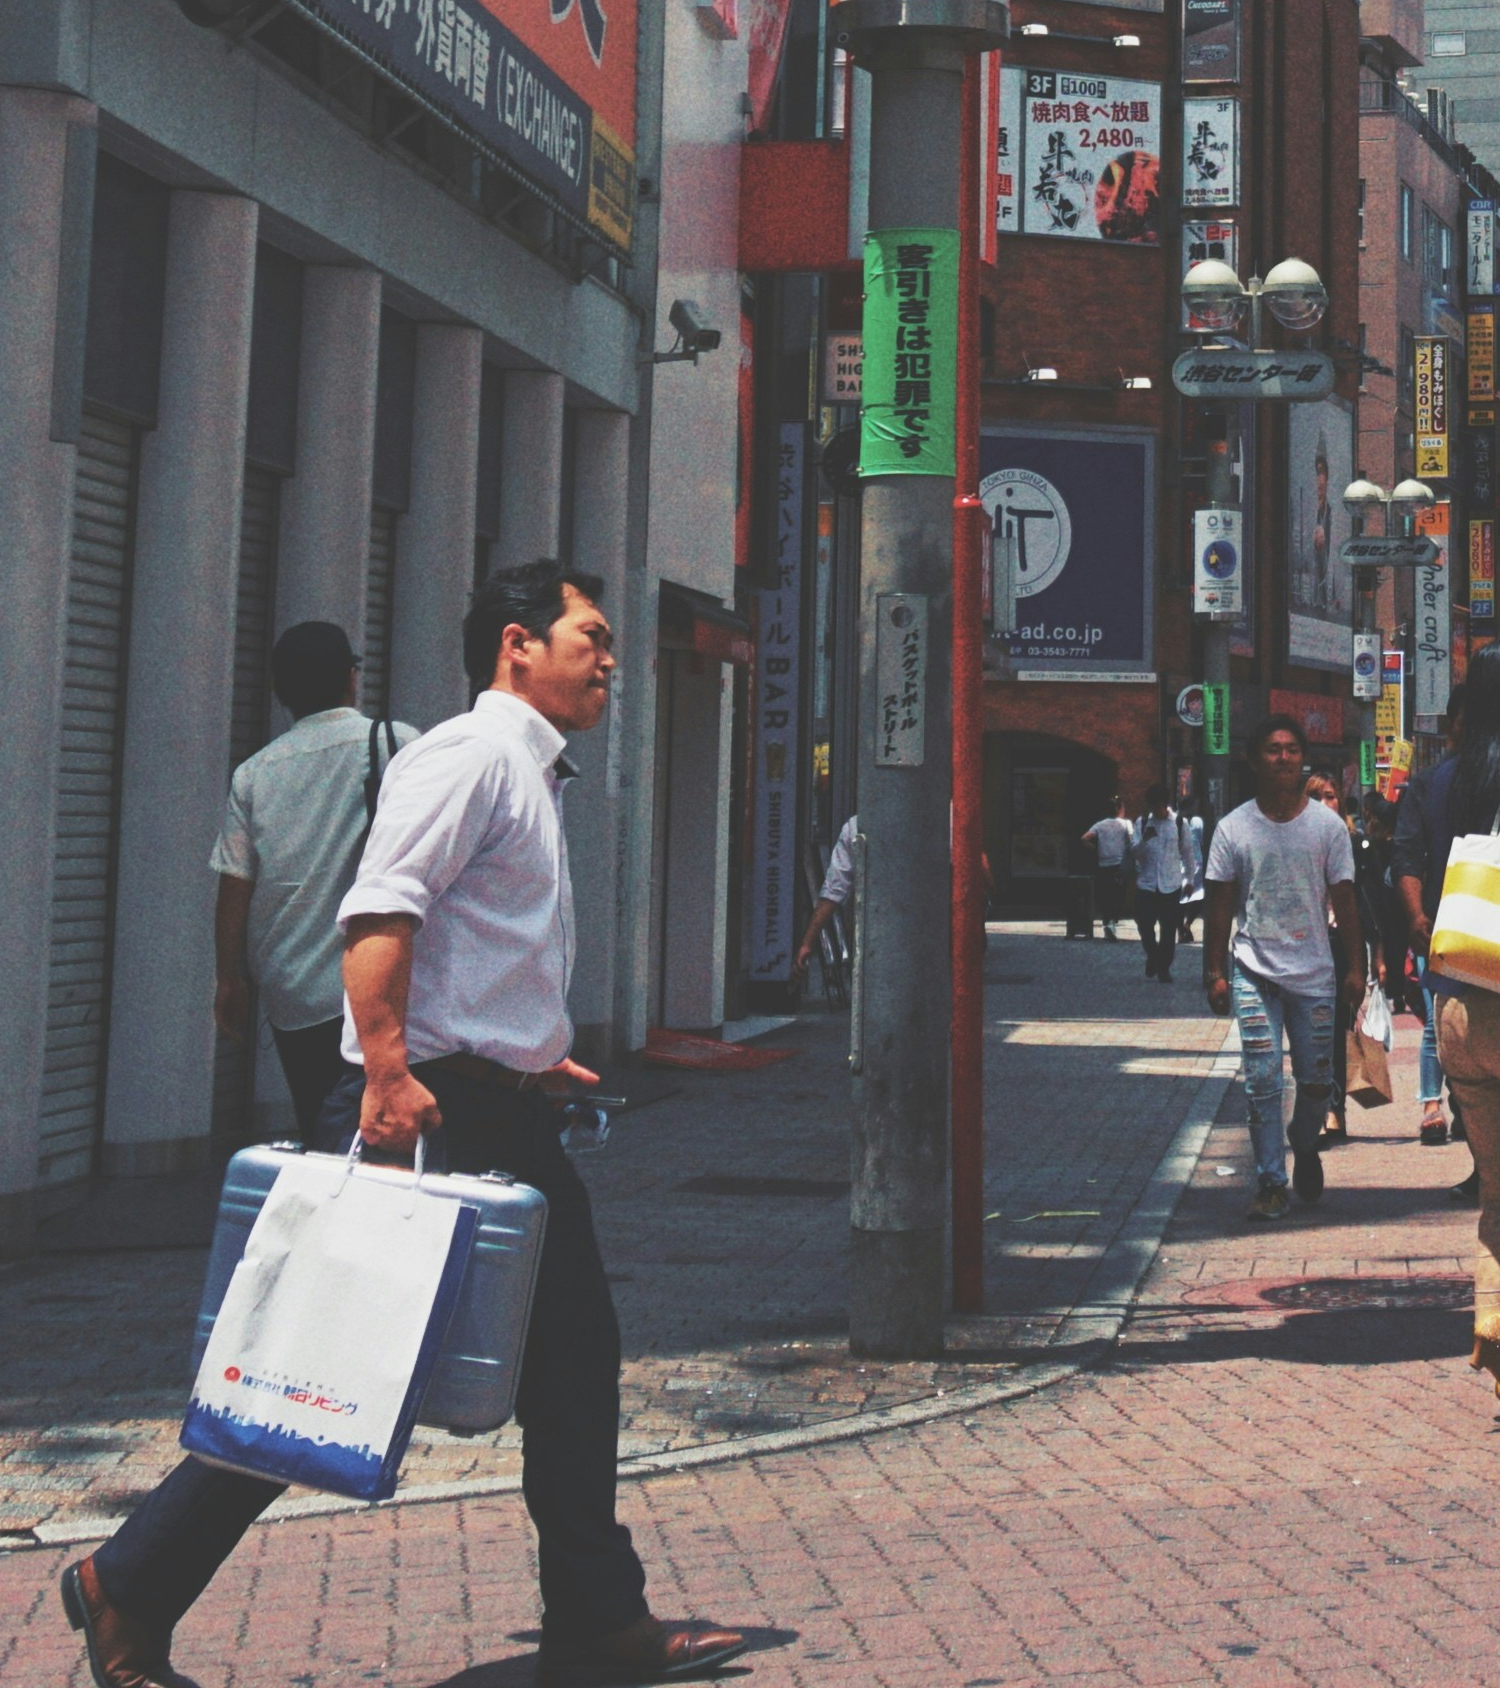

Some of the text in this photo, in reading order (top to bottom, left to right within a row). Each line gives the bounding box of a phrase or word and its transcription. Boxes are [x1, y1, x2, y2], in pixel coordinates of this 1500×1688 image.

[1030, 75, 1052, 94] 3F
[1216, 102, 1230, 113] 3F
[1032, 101, 1149, 124] 焼肉食べ放題
[1470, 199, 1491, 211] CBR
[1470, 214, 1483, 287] モニタールーム
[893, 243, 932, 460] 客引きは犯罪です
[1182, 362, 1324, 385] 渋谷センター街
[1432, 344, 1445, 433] 全身もみほぐし
[980, 470, 1049, 494] TOKYO GINZA
[1474, 602, 1491, 614] 2F
[1418, 615, 1447, 663] craft
[764, 658, 791, 730] BAR
[902, 628, 920, 731] バスケットボール
[883, 693, 901, 759] ストリート
[765, 791, 783, 947] SHIBUYA HIGHBALL
